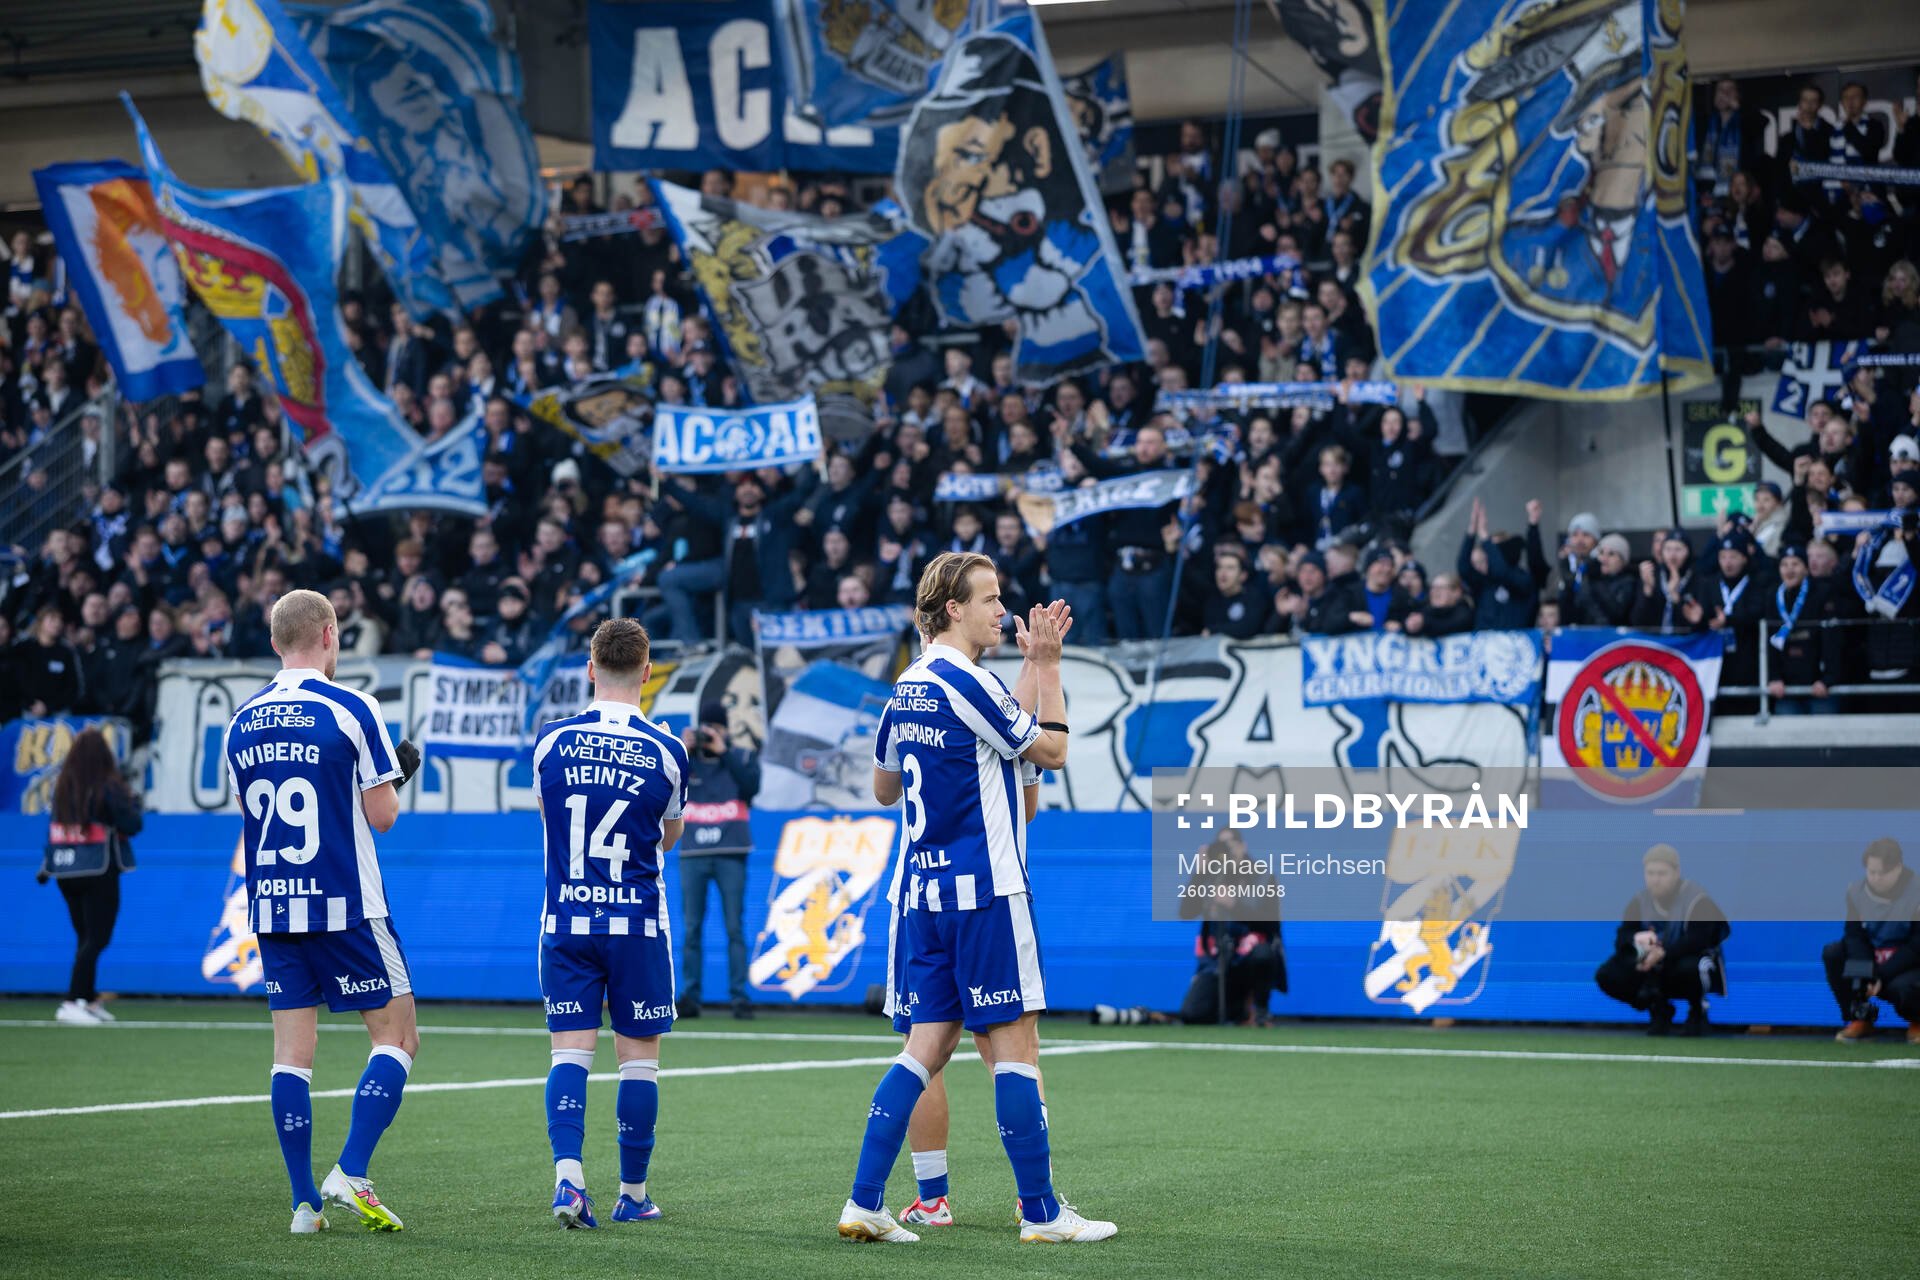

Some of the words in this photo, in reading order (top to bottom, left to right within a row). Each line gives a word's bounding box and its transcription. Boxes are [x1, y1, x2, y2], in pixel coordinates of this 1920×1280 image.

[653, 413, 714, 465] AC
[1703, 424, 1747, 483] G
[1307, 632, 1472, 677] YNGRE
[436, 675, 528, 705] SYMPAT
[896, 684, 928, 697] NORDIC
[240, 716, 316, 733] WELLNESS
[251, 705, 303, 720] NORDIC
[431, 710, 453, 734] DE
[575, 733, 643, 754] NORDIC
[235, 742, 320, 770] WIBERG
[558, 744, 657, 769] WELLNESS
[565, 765, 646, 796] HEINTZ
[245, 777, 320, 867] 29
[565, 794, 631, 883] 14
[910, 850, 951, 869] ILL
[558, 884, 643, 904] MOBILL
[340, 977, 389, 996] RASTA
[972, 989, 1021, 1008] RASTA
[634, 1005, 672, 1020] RASTA
